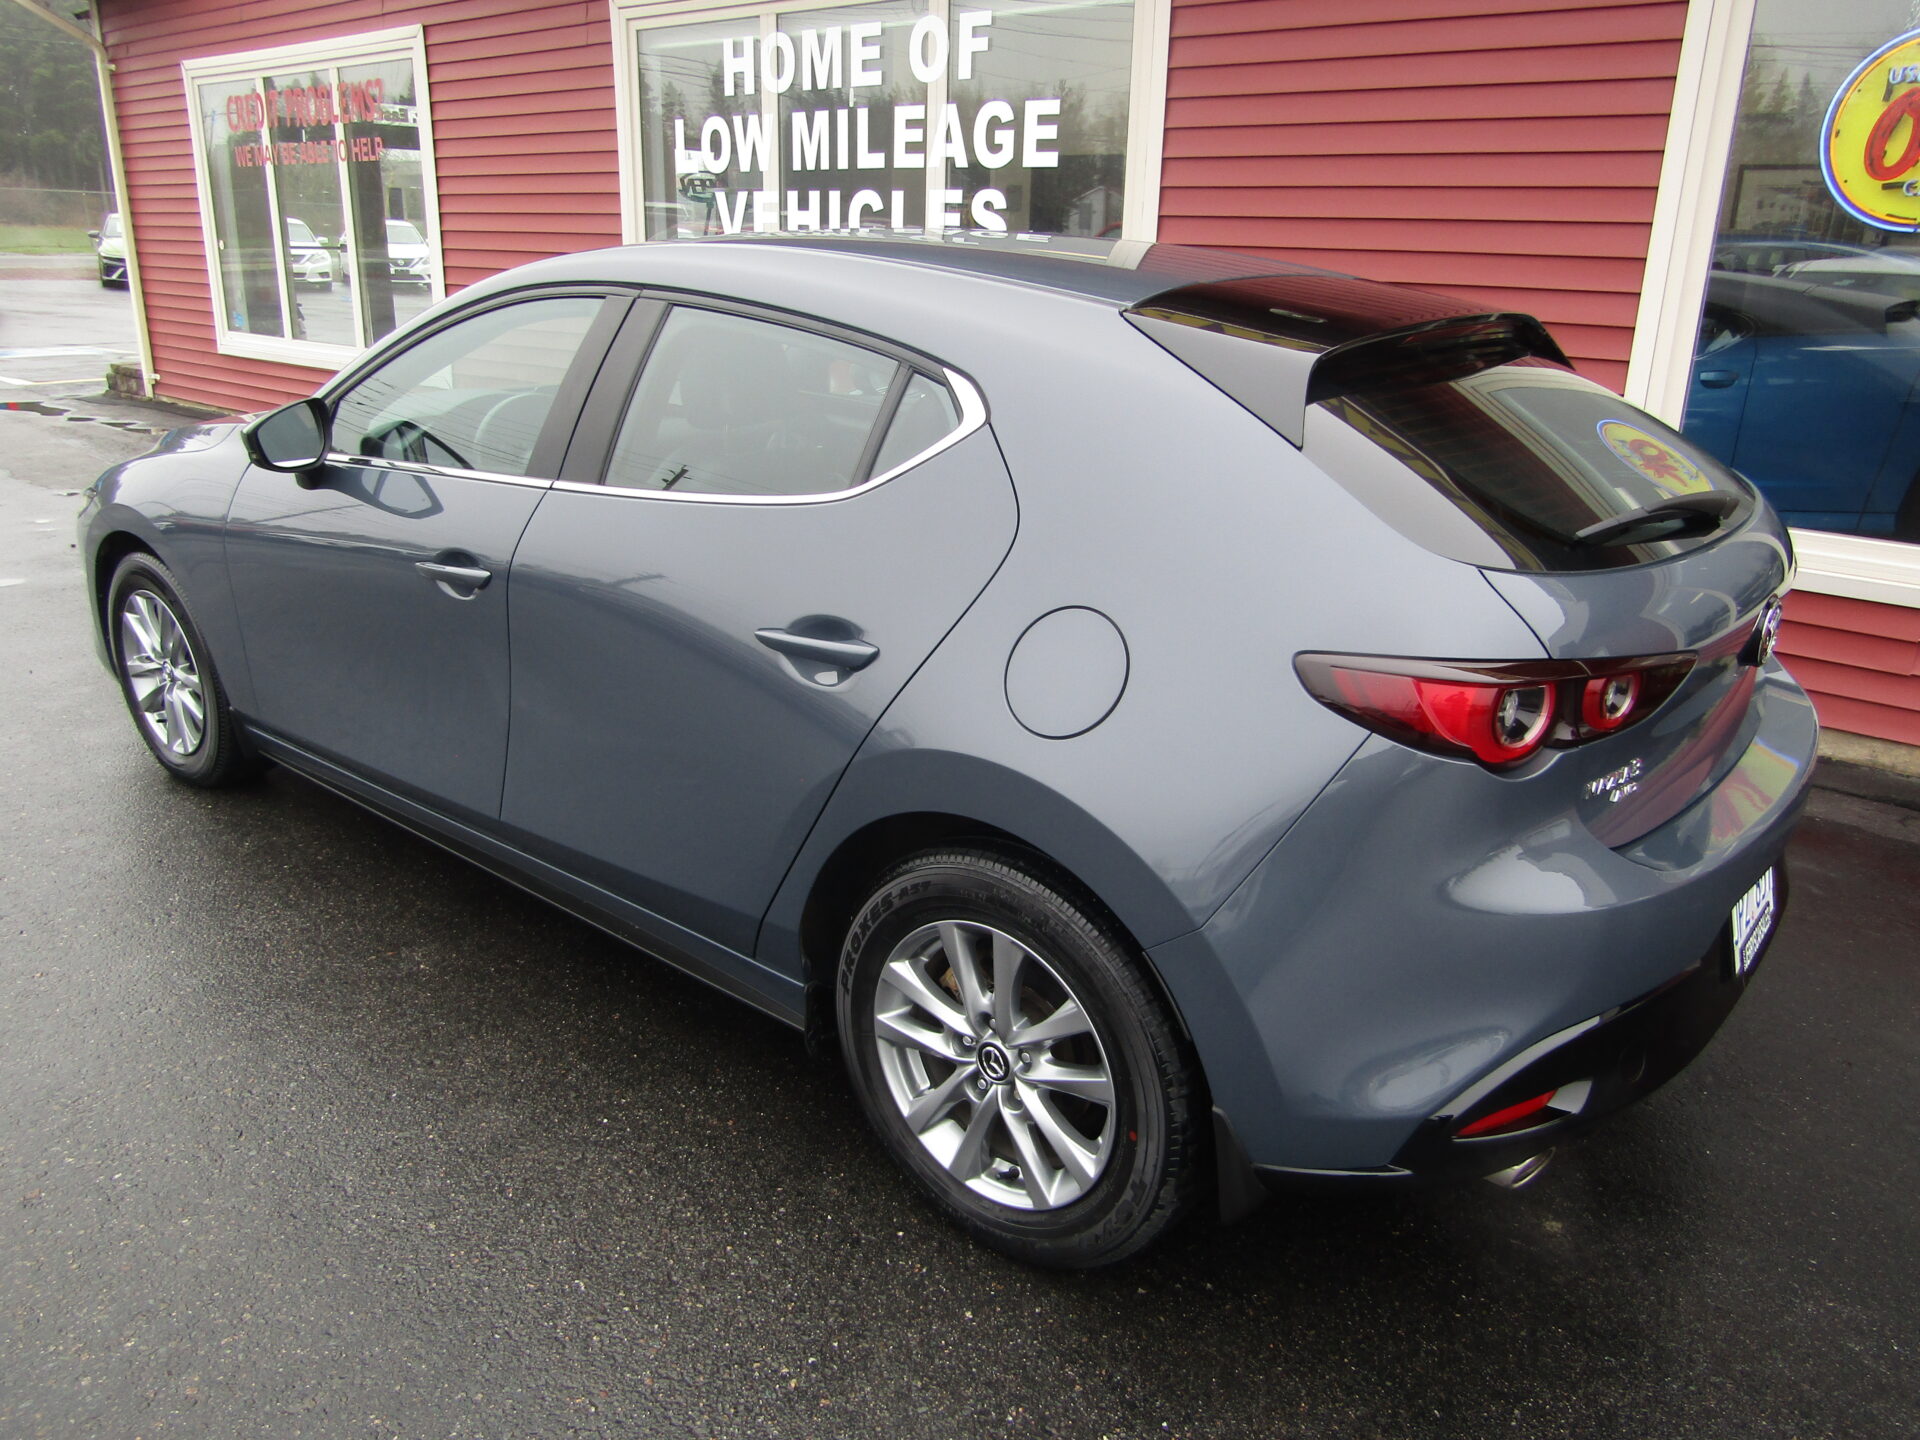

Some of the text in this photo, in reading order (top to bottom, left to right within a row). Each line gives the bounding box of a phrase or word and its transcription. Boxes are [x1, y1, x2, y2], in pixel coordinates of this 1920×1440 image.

[722, 10, 993, 97] HOME OF
[226, 88, 279, 133] CREDIT
[284, 78, 384, 128] PROBLEMS?
[674, 98, 1061, 175] LOW MILEAGE
[234, 136, 384, 168] WE MAY BE ABLE TO HELP
